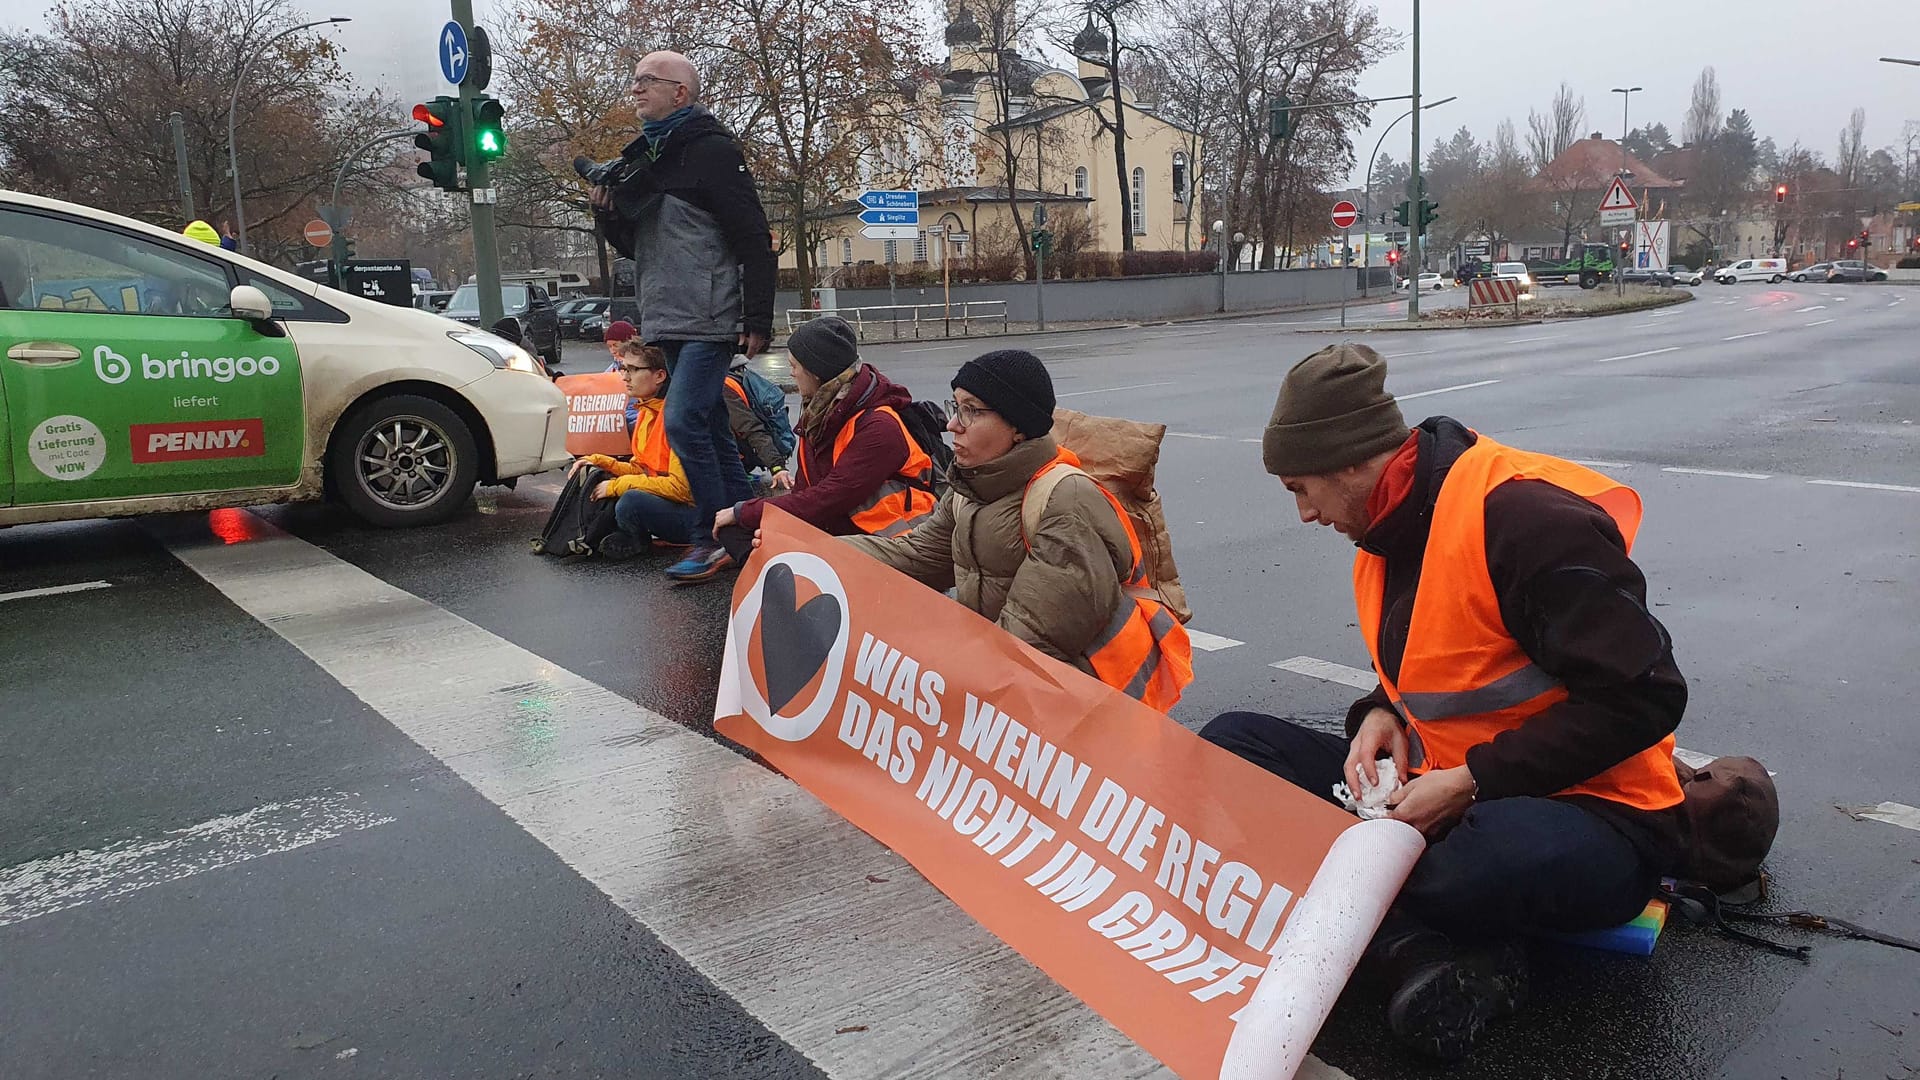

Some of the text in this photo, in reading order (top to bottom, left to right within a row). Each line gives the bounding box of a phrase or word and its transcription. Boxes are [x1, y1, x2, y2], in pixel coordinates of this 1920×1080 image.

[886, 200, 916, 208] Schöneberg
[141, 350, 280, 383] bringoo
[173, 395, 219, 408] liefert
[572, 393, 626, 412] REGIERUNG
[45, 421, 82, 435] Gratis
[567, 413, 625, 433] GRIFF HAT?
[48, 449, 91, 461] mit Code
[54, 461, 86, 474] WOW
[853, 631, 1304, 957] WAS, WENN DIE REGI
[837, 689, 1266, 1003] DAS NICHT IM GRIFF
